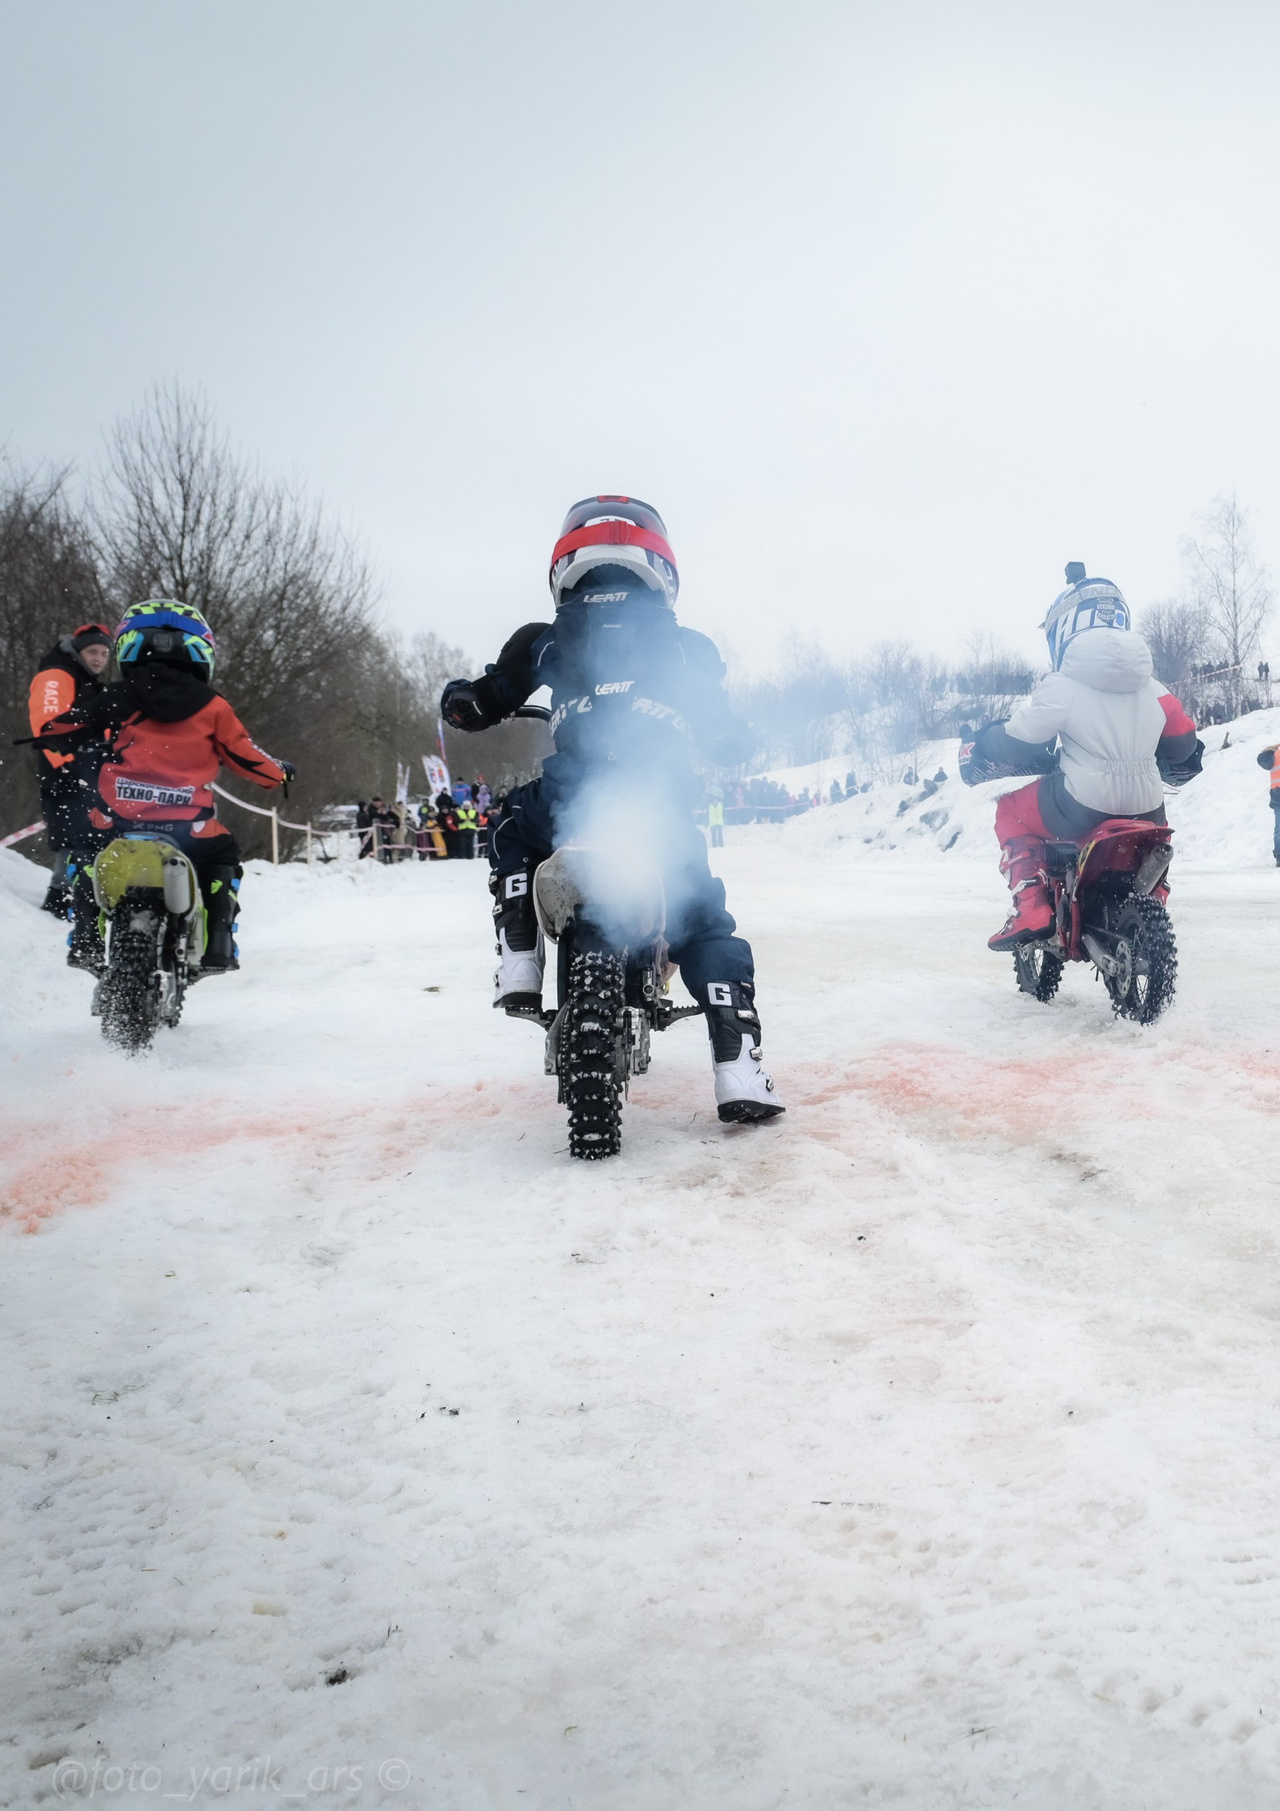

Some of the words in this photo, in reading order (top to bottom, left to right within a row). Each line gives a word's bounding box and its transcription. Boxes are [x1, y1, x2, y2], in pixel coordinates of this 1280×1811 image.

[583, 591, 630, 603] LEATT
[44, 680, 59, 714] RACE
[595, 681, 635, 695] LEATT
[505, 872, 527, 899] G
[707, 982, 732, 1007] G
